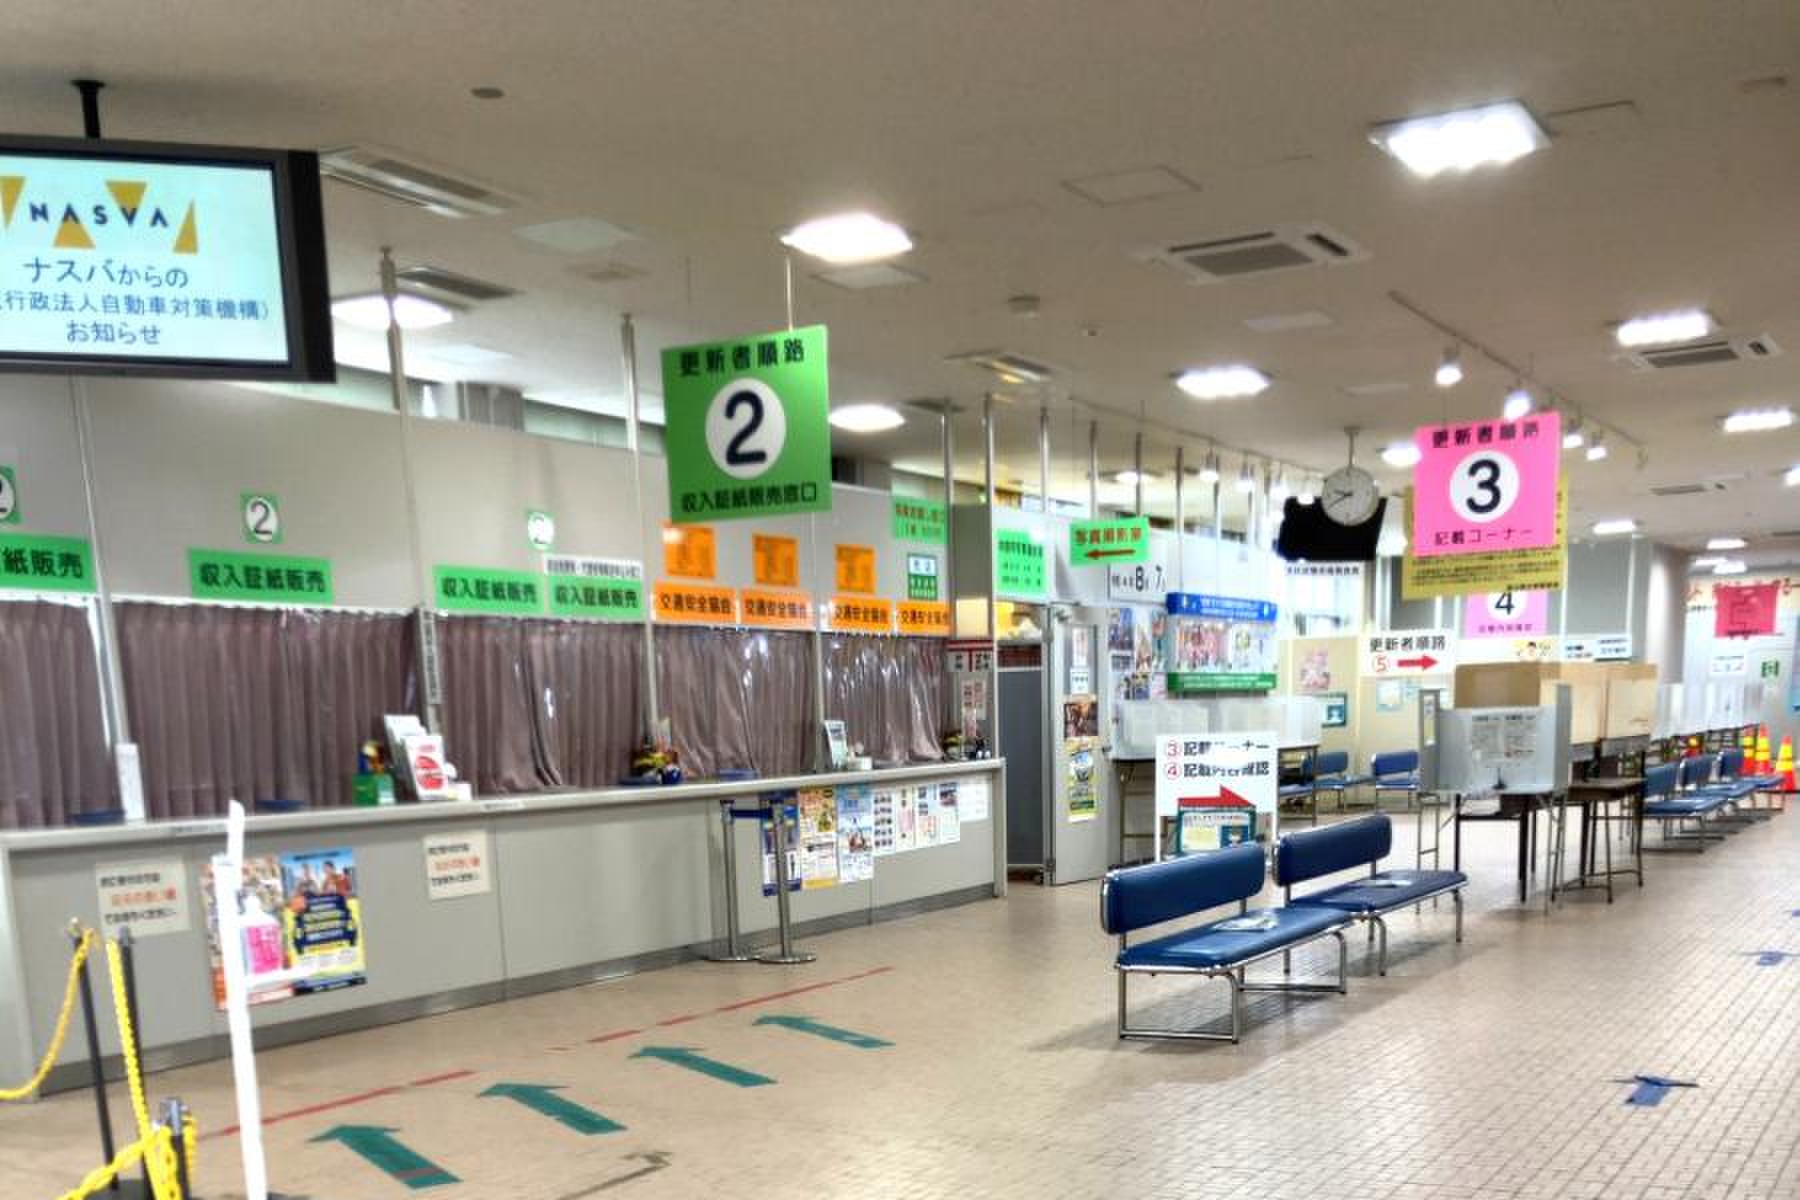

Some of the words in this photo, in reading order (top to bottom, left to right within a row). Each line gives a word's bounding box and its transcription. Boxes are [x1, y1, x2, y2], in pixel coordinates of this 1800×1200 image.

[29, 202, 169, 228] NASVA
[23, 256, 190, 289] ナスバからの
[66, 320, 161, 345] お知らせ
[724, 389, 767, 466] 2
[1466, 459, 1502, 514] 3
[250, 500, 273, 535] 2
[1494, 591, 1515, 615] 4
[1369, 635, 1446, 652] 更新者順路
